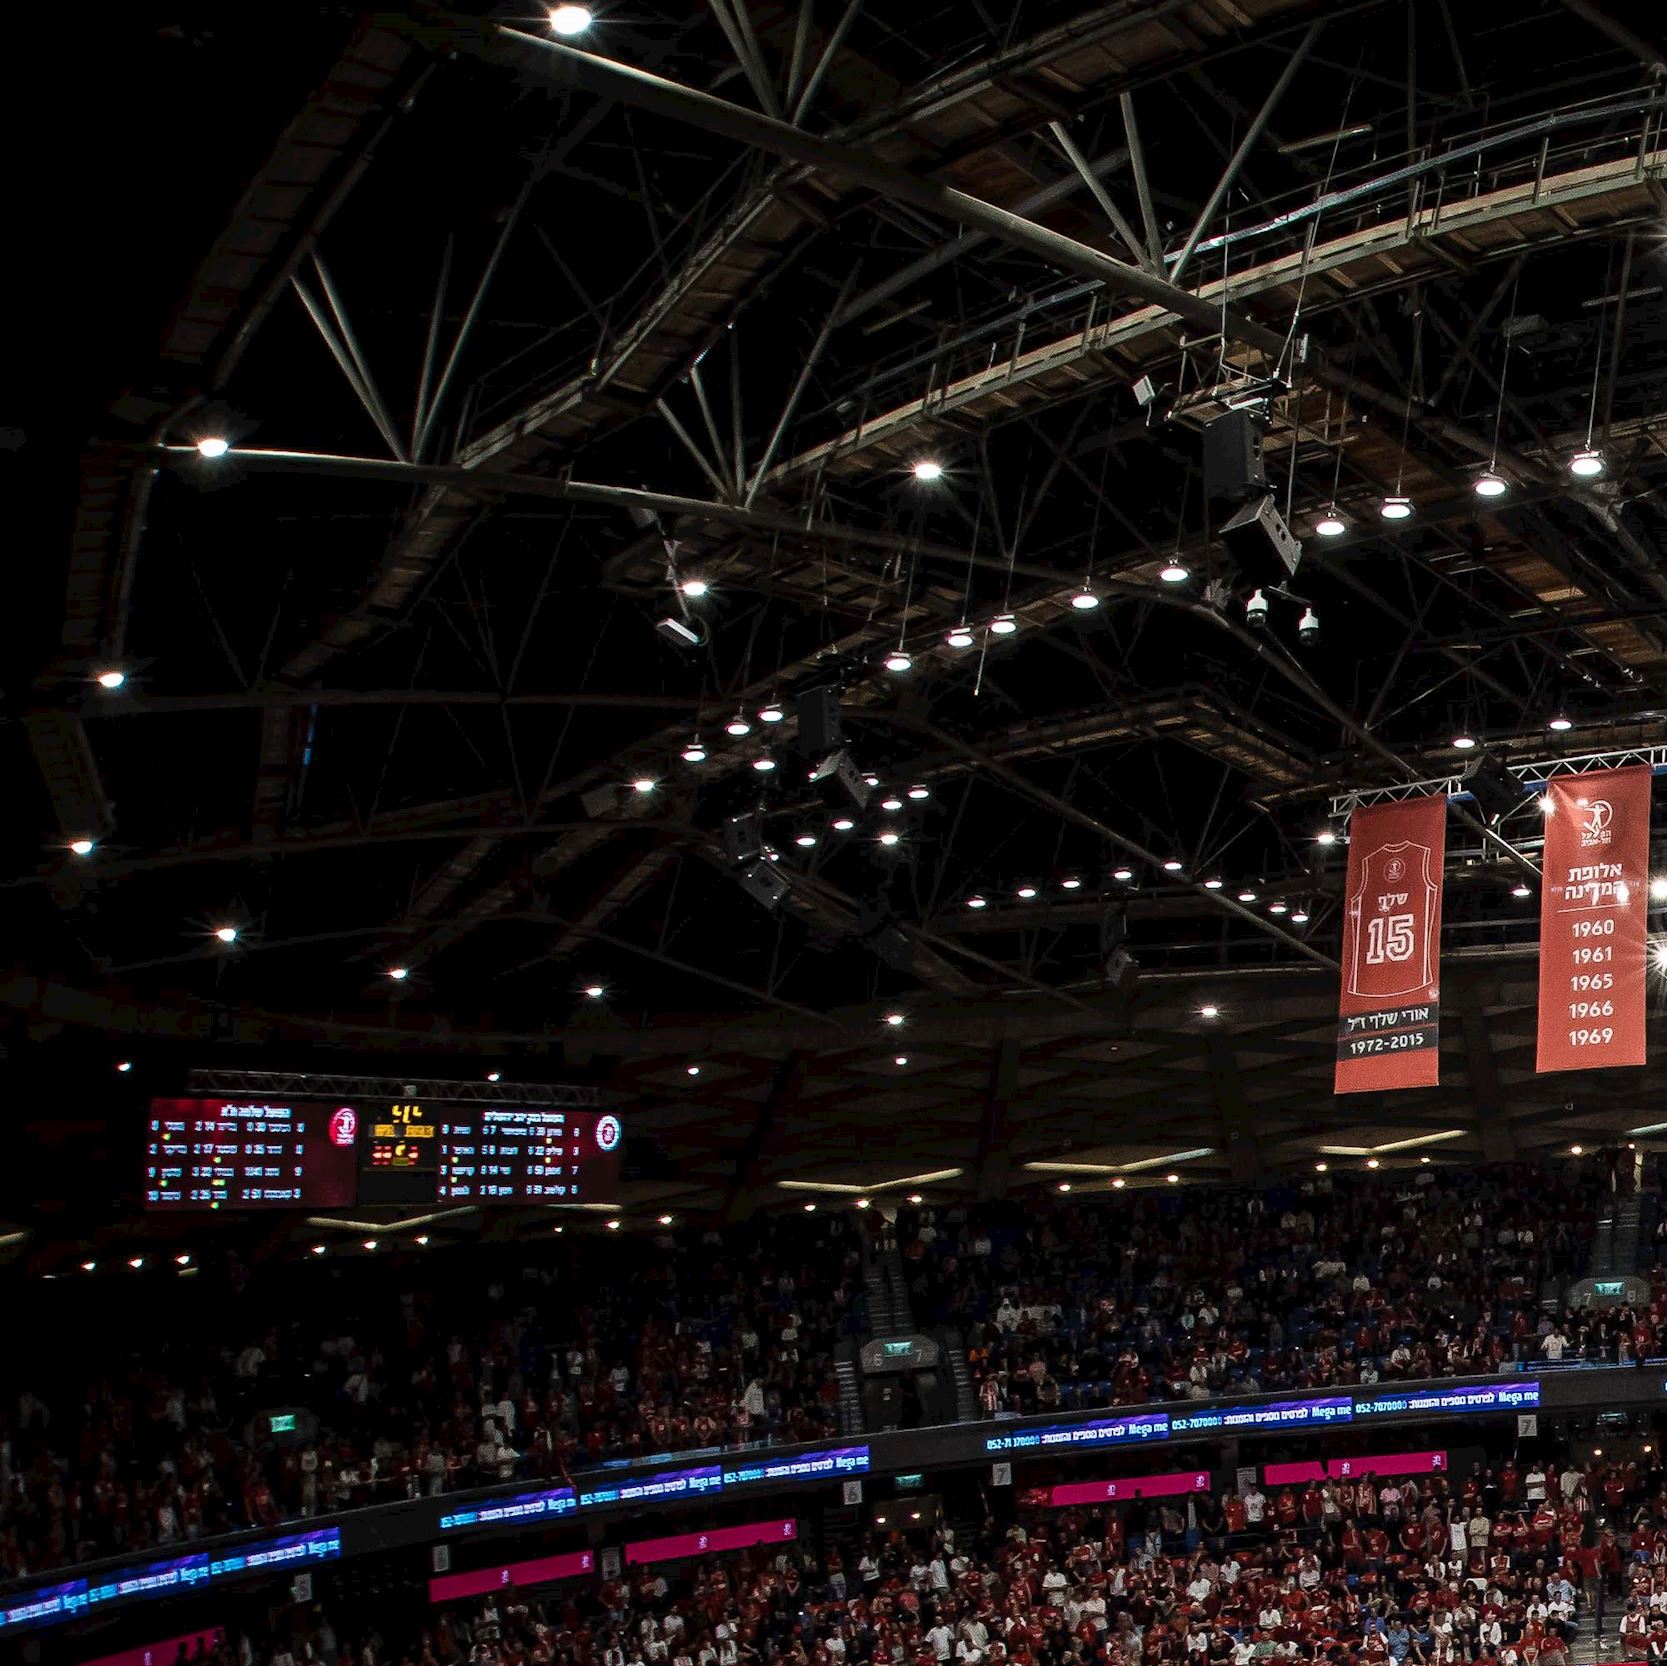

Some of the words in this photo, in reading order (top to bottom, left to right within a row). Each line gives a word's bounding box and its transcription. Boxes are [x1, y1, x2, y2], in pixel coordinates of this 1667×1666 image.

[1568, 863, 1623, 882] אלופת
[1572, 919, 1615, 938] 1960
[1366, 913, 1415, 965] 15
[1572, 946, 1613, 965] 1961
[1570, 973, 1614, 992] 1965
[1401, 1007, 1429, 1023] אורי
[1568, 1001, 1614, 1019] 1966
[1370, 1011, 1399, 1029] שלף
[1350, 1032, 1424, 1055] 1972-2015
[1568, 1027, 1614, 1047] 1969
[1498, 1391, 1521, 1405] Mega
[1523, 1391, 1539, 1401] me
[1312, 1405, 1336, 1418] Mega
[1337, 1405, 1352, 1415] me
[1129, 1423, 1151, 1438] Mega
[1153, 1422, 1169, 1433] me
[1522, 1418, 1532, 1433] 7
